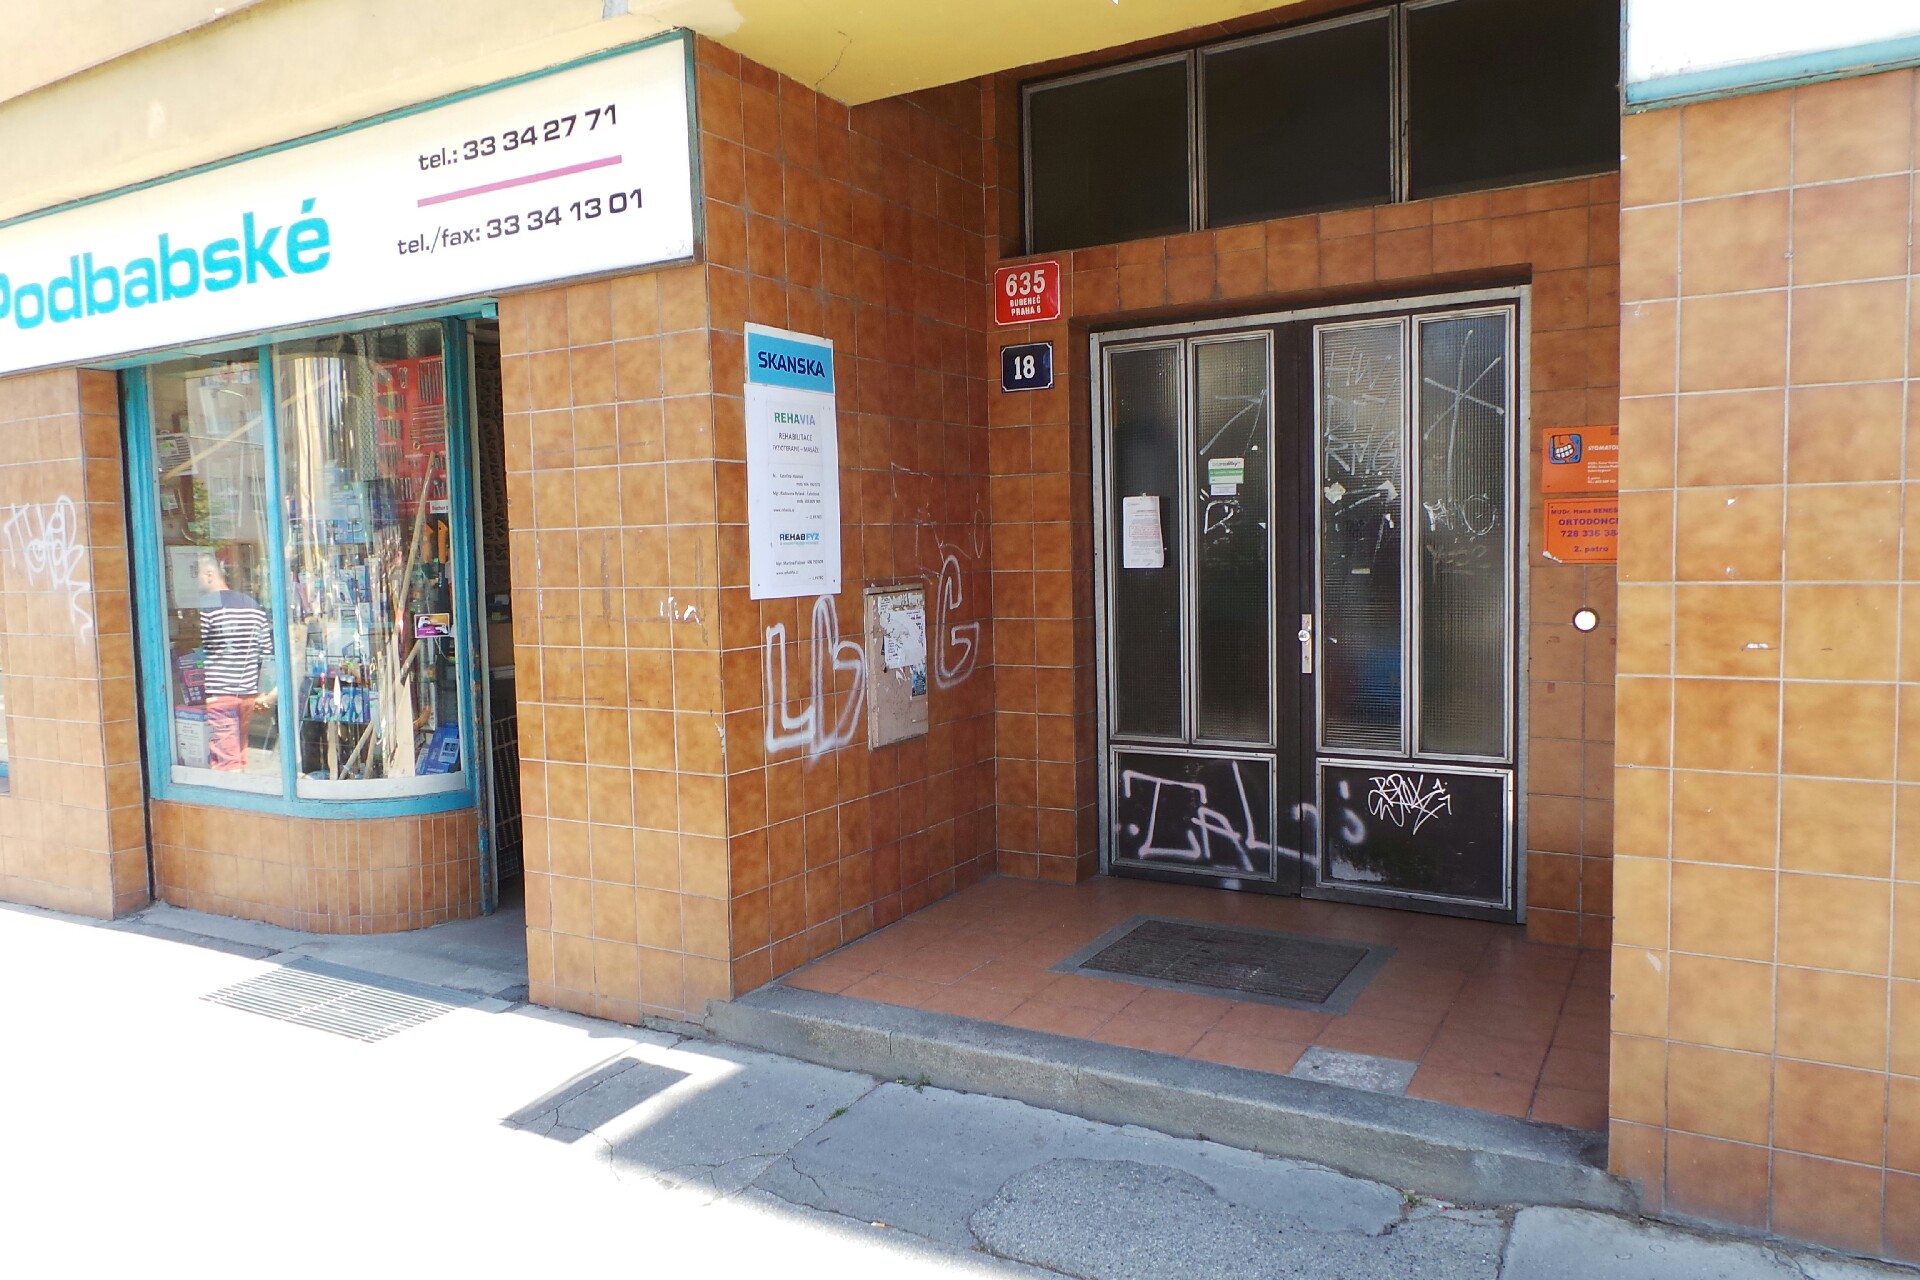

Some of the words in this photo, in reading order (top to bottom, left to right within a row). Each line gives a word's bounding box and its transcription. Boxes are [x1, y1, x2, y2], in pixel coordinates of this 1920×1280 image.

[418, 147, 458, 171] tel.:
[463, 136, 496, 161] 33
[502, 125, 538, 152] 34
[543, 114, 577, 142] 27
[584, 104, 617, 131] 71
[397, 226, 481, 255] tel./fax:
[486, 214, 520, 239] 33
[527, 206, 562, 231] 34
[569, 197, 602, 222] 13
[608, 188, 642, 214] 01
[1005, 269, 1045, 297] 635
[1011, 307, 1035, 317] PRAHA
[758, 351, 825, 378] SKANSKA
[1014, 355, 1036, 380] 18
[774, 412, 816, 426] REHAVIA
[779, 532, 819, 541] REHABFYZ
[1560, 530, 1579, 538] 728
